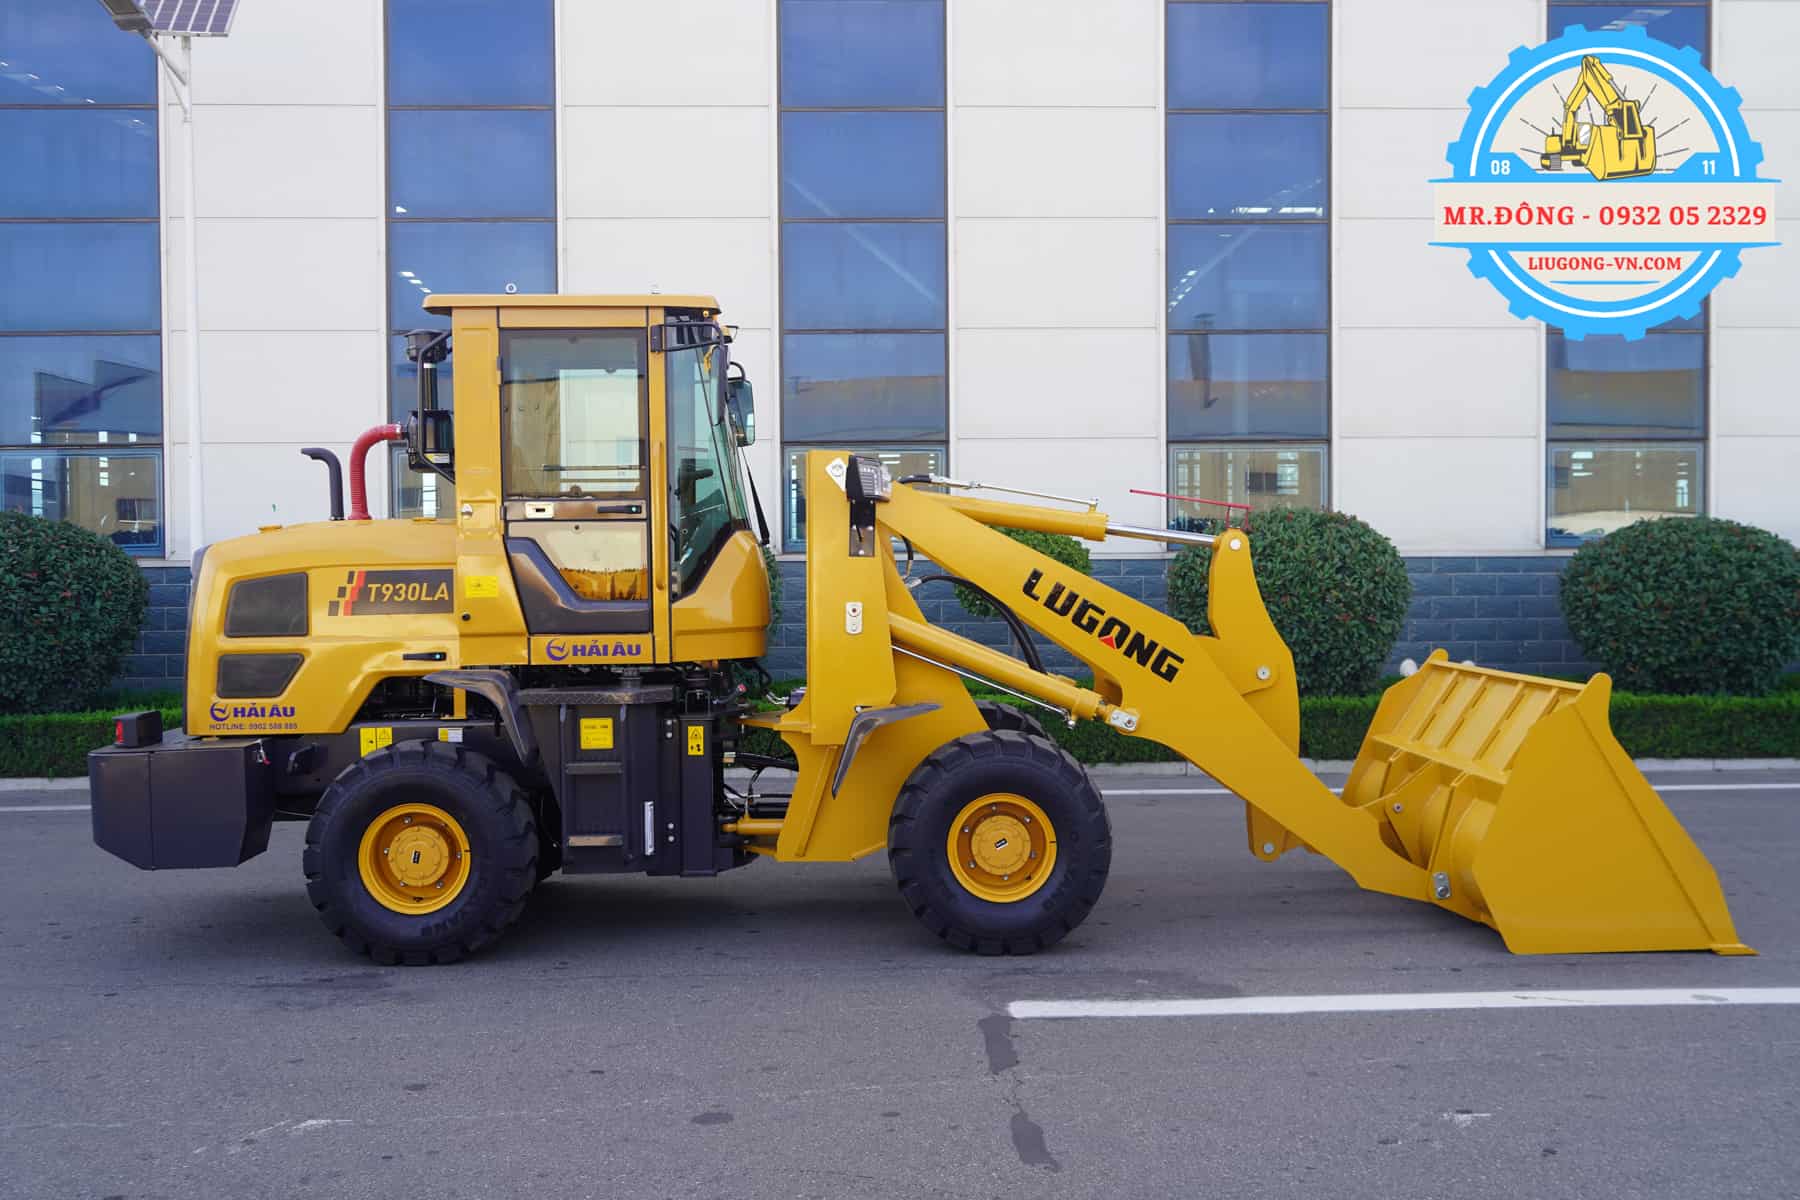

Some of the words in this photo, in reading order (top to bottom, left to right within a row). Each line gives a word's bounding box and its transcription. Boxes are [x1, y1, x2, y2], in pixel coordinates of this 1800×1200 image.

[367, 582, 449, 602] T930LA
[1023, 568, 1185, 683] LUGONG
[612, 641, 641, 656] ÂU
[269, 704, 296, 717] ÂU
